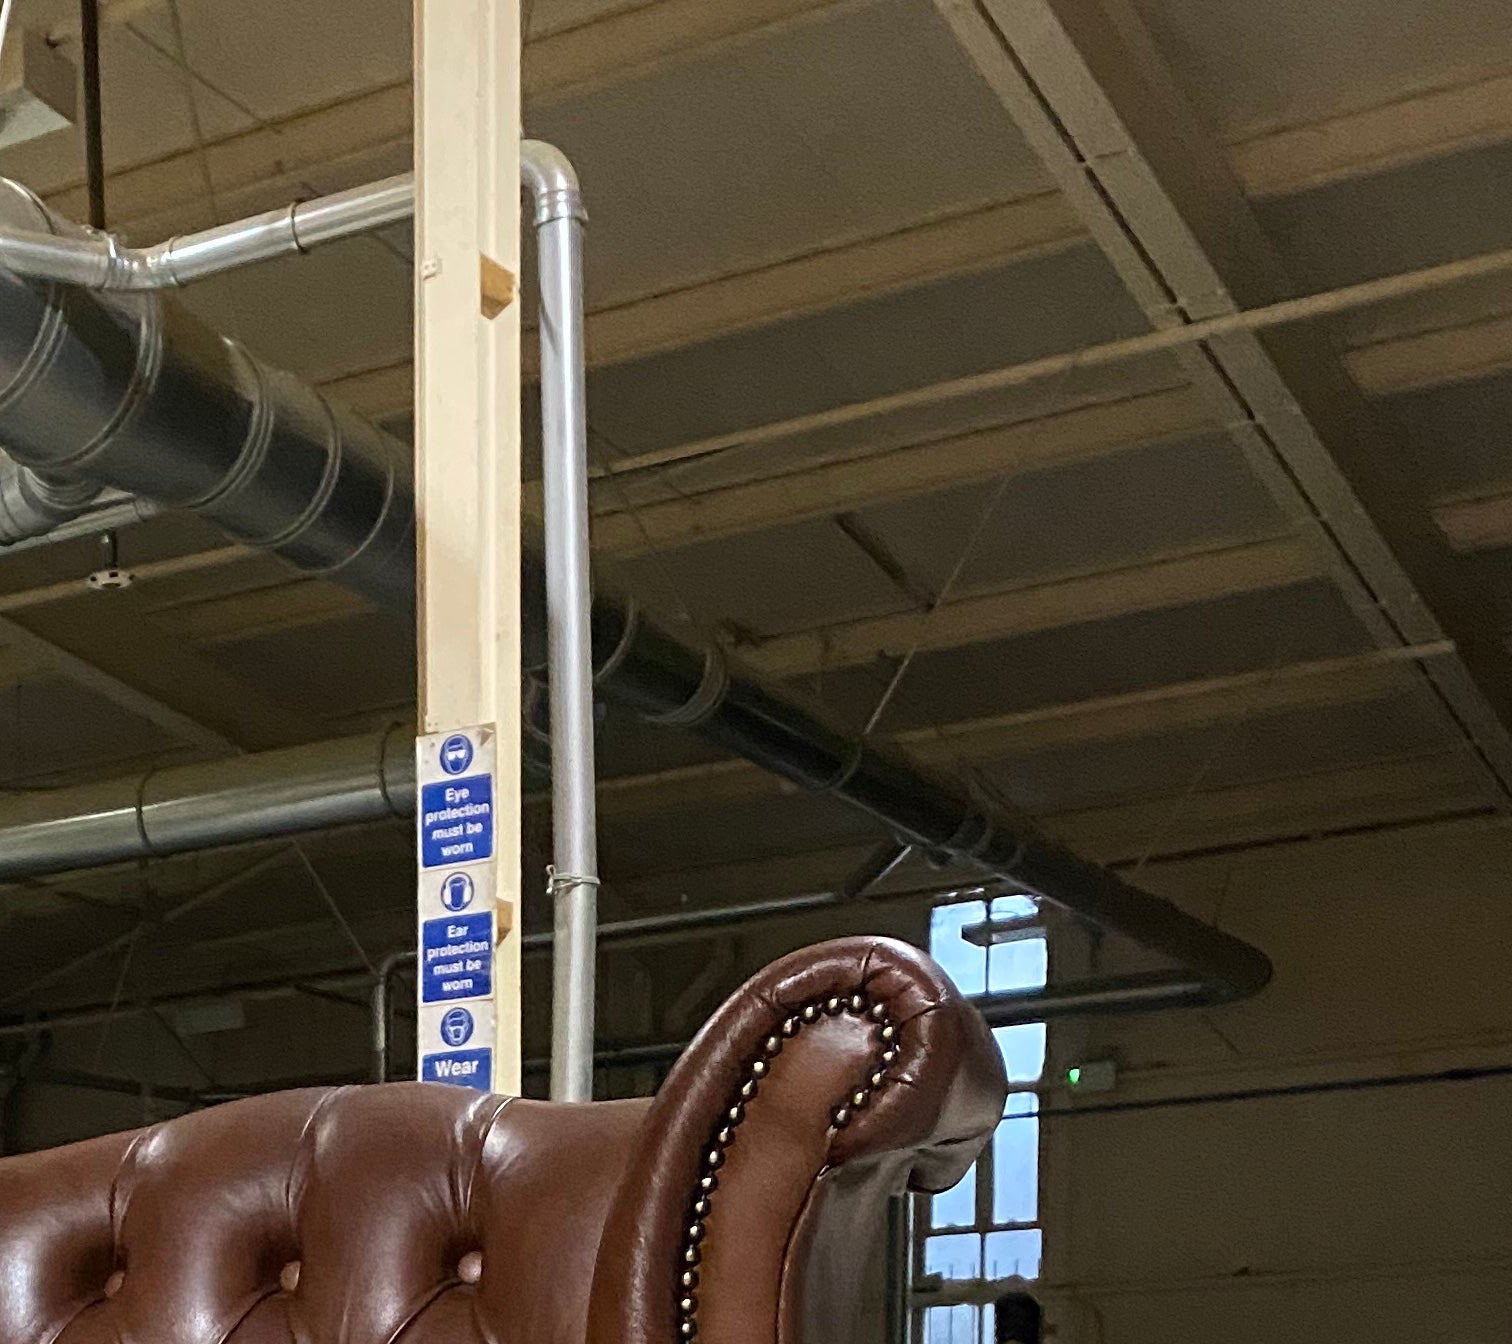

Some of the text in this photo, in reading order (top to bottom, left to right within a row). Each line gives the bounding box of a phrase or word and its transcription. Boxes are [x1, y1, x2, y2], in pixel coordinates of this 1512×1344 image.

[445, 788, 470, 802] Eye
[425, 803, 489, 825] protection
[432, 822, 484, 840] must be
[441, 842, 473, 856] worn
[447, 925, 469, 938] Ear
[427, 941, 489, 962] protection
[433, 959, 482, 975] must be
[442, 979, 473, 991] worn
[434, 1059, 479, 1077] Wear
